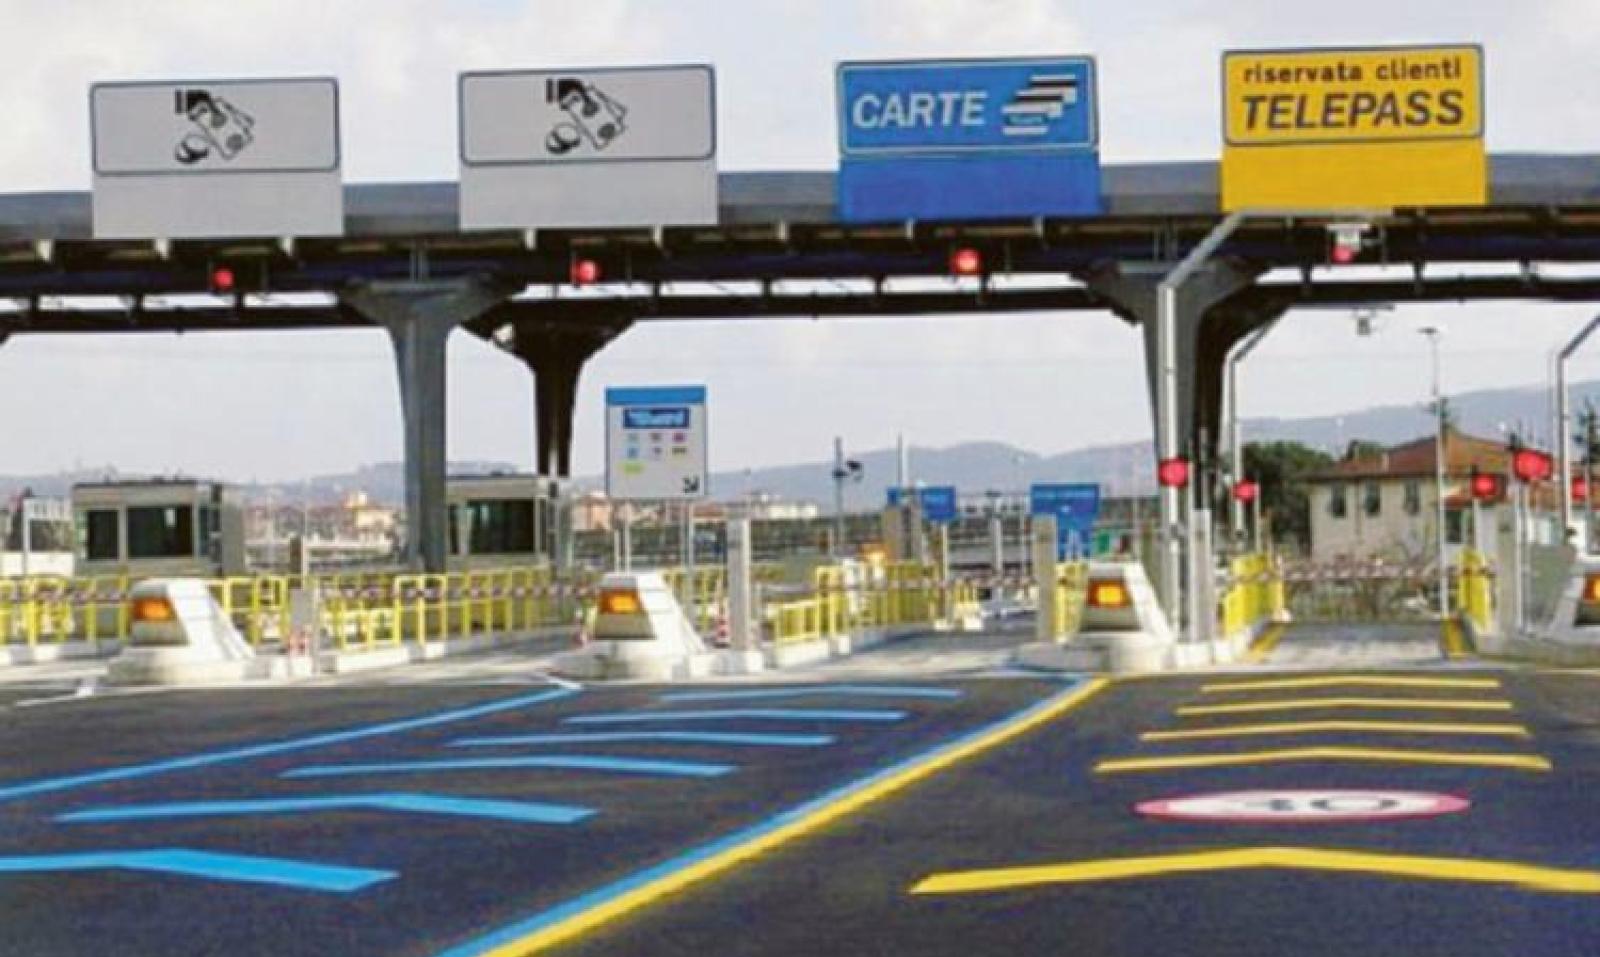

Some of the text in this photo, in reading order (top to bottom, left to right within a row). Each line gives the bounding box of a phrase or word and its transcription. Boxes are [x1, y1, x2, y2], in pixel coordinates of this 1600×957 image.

[1243, 57, 1462, 83] riservata clienti
[852, 91, 988, 128] CARTE
[1242, 90, 1464, 130] TELEPASS
